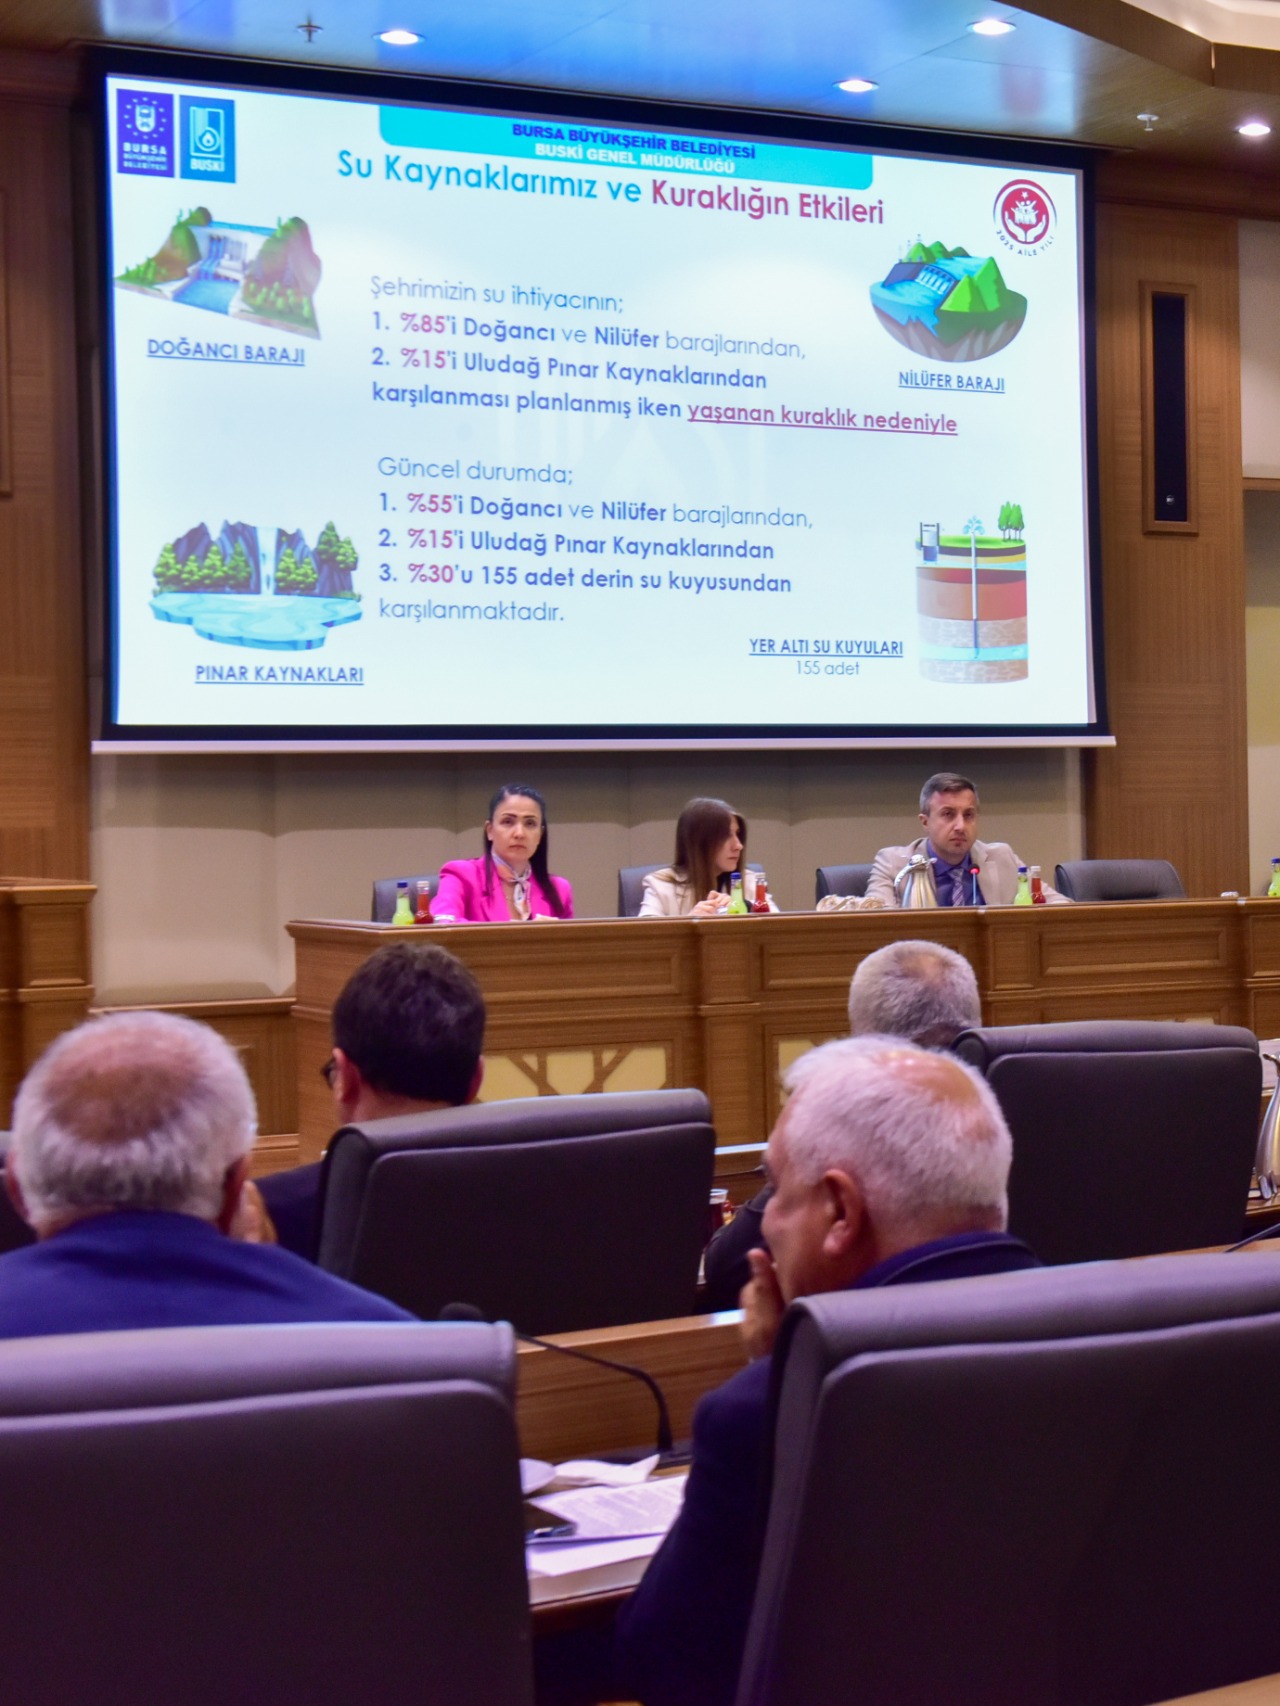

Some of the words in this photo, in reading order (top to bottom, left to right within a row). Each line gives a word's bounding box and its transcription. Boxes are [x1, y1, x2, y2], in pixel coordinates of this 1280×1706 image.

[123, 142, 167, 155] BURSA
[512, 123, 565, 141] BURSA
[569, 126, 667, 150] BÜYÜKŞEHİR
[671, 140, 756, 159] BELEDİYESİ
[535, 143, 584, 160] BUSKİ
[587, 148, 636, 165] GENEL
[641, 151, 735, 174] MÜDÜRLÜĞÜ
[337, 149, 372, 178] Su
[385, 154, 598, 199] Kaynaklarımız
[606, 181, 642, 203] ve
[651, 179, 789, 220] Kuraklığın
[799, 192, 884, 225] Etkileri
[370, 275, 476, 301] Şehrimizin
[483, 288, 505, 303] su
[512, 285, 624, 313] ihtiyacının;
[147, 337, 238, 359] DOĞANCI
[244, 345, 305, 363] BARAJI
[372, 311, 390, 330] 1.
[400, 312, 457, 335] %85'i
[464, 317, 555, 342] Doğancı
[561, 327, 588, 343] ve
[594, 326, 659, 348] Nilüfer
[665, 331, 806, 360] barajlarından,
[371, 347, 390, 366] 2.
[400, 347, 457, 370] %15'i
[464, 352, 540, 379] Uludağ
[548, 358, 599, 378] Pınar
[606, 361, 767, 389] Kaynaklarından
[899, 369, 951, 388] NİLÜFER
[957, 375, 1005, 391] BARAJI
[372, 382, 509, 408] karşılanması
[517, 391, 631, 418] planlanmış
[638, 397, 681, 417] iken
[687, 404, 775, 425] yaşanan
[781, 405, 857, 427] kuraklık
[863, 412, 957, 435] nedeniyle
[377, 456, 460, 479] Güncel
[466, 460, 573, 485] durumda;
[379, 492, 397, 512] 1.
[406, 492, 463, 514] %55'i
[471, 496, 562, 520] Doğancı
[568, 504, 594, 519] ve
[601, 501, 667, 522] Nilüfer
[673, 503, 813, 529] barajlarından,
[378, 528, 397, 547] 2.
[407, 528, 463, 549] %15'i
[471, 531, 546, 556] Uludağ
[555, 534, 606, 554] Pınar
[613, 536, 774, 559] Kaynaklarından
[379, 563, 397, 582] 3.
[408, 563, 473, 584] %30'u
[482, 566, 517, 584] 155
[525, 567, 574, 587] adet
[581, 568, 633, 588] derin
[640, 575, 661, 589] su
[669, 570, 792, 594] kuyusundan
[379, 598, 564, 622] karşılanmaktadır.
[750, 639, 775, 653] YER
[781, 639, 809, 653] ALTI
[813, 640, 831, 653] SU
[835, 640, 903, 655] KUYULARI
[195, 665, 248, 680] PINAR
[254, 666, 363, 682] KAYNAKLARI
[797, 660, 820, 675] 155
[824, 661, 860, 675] adet
